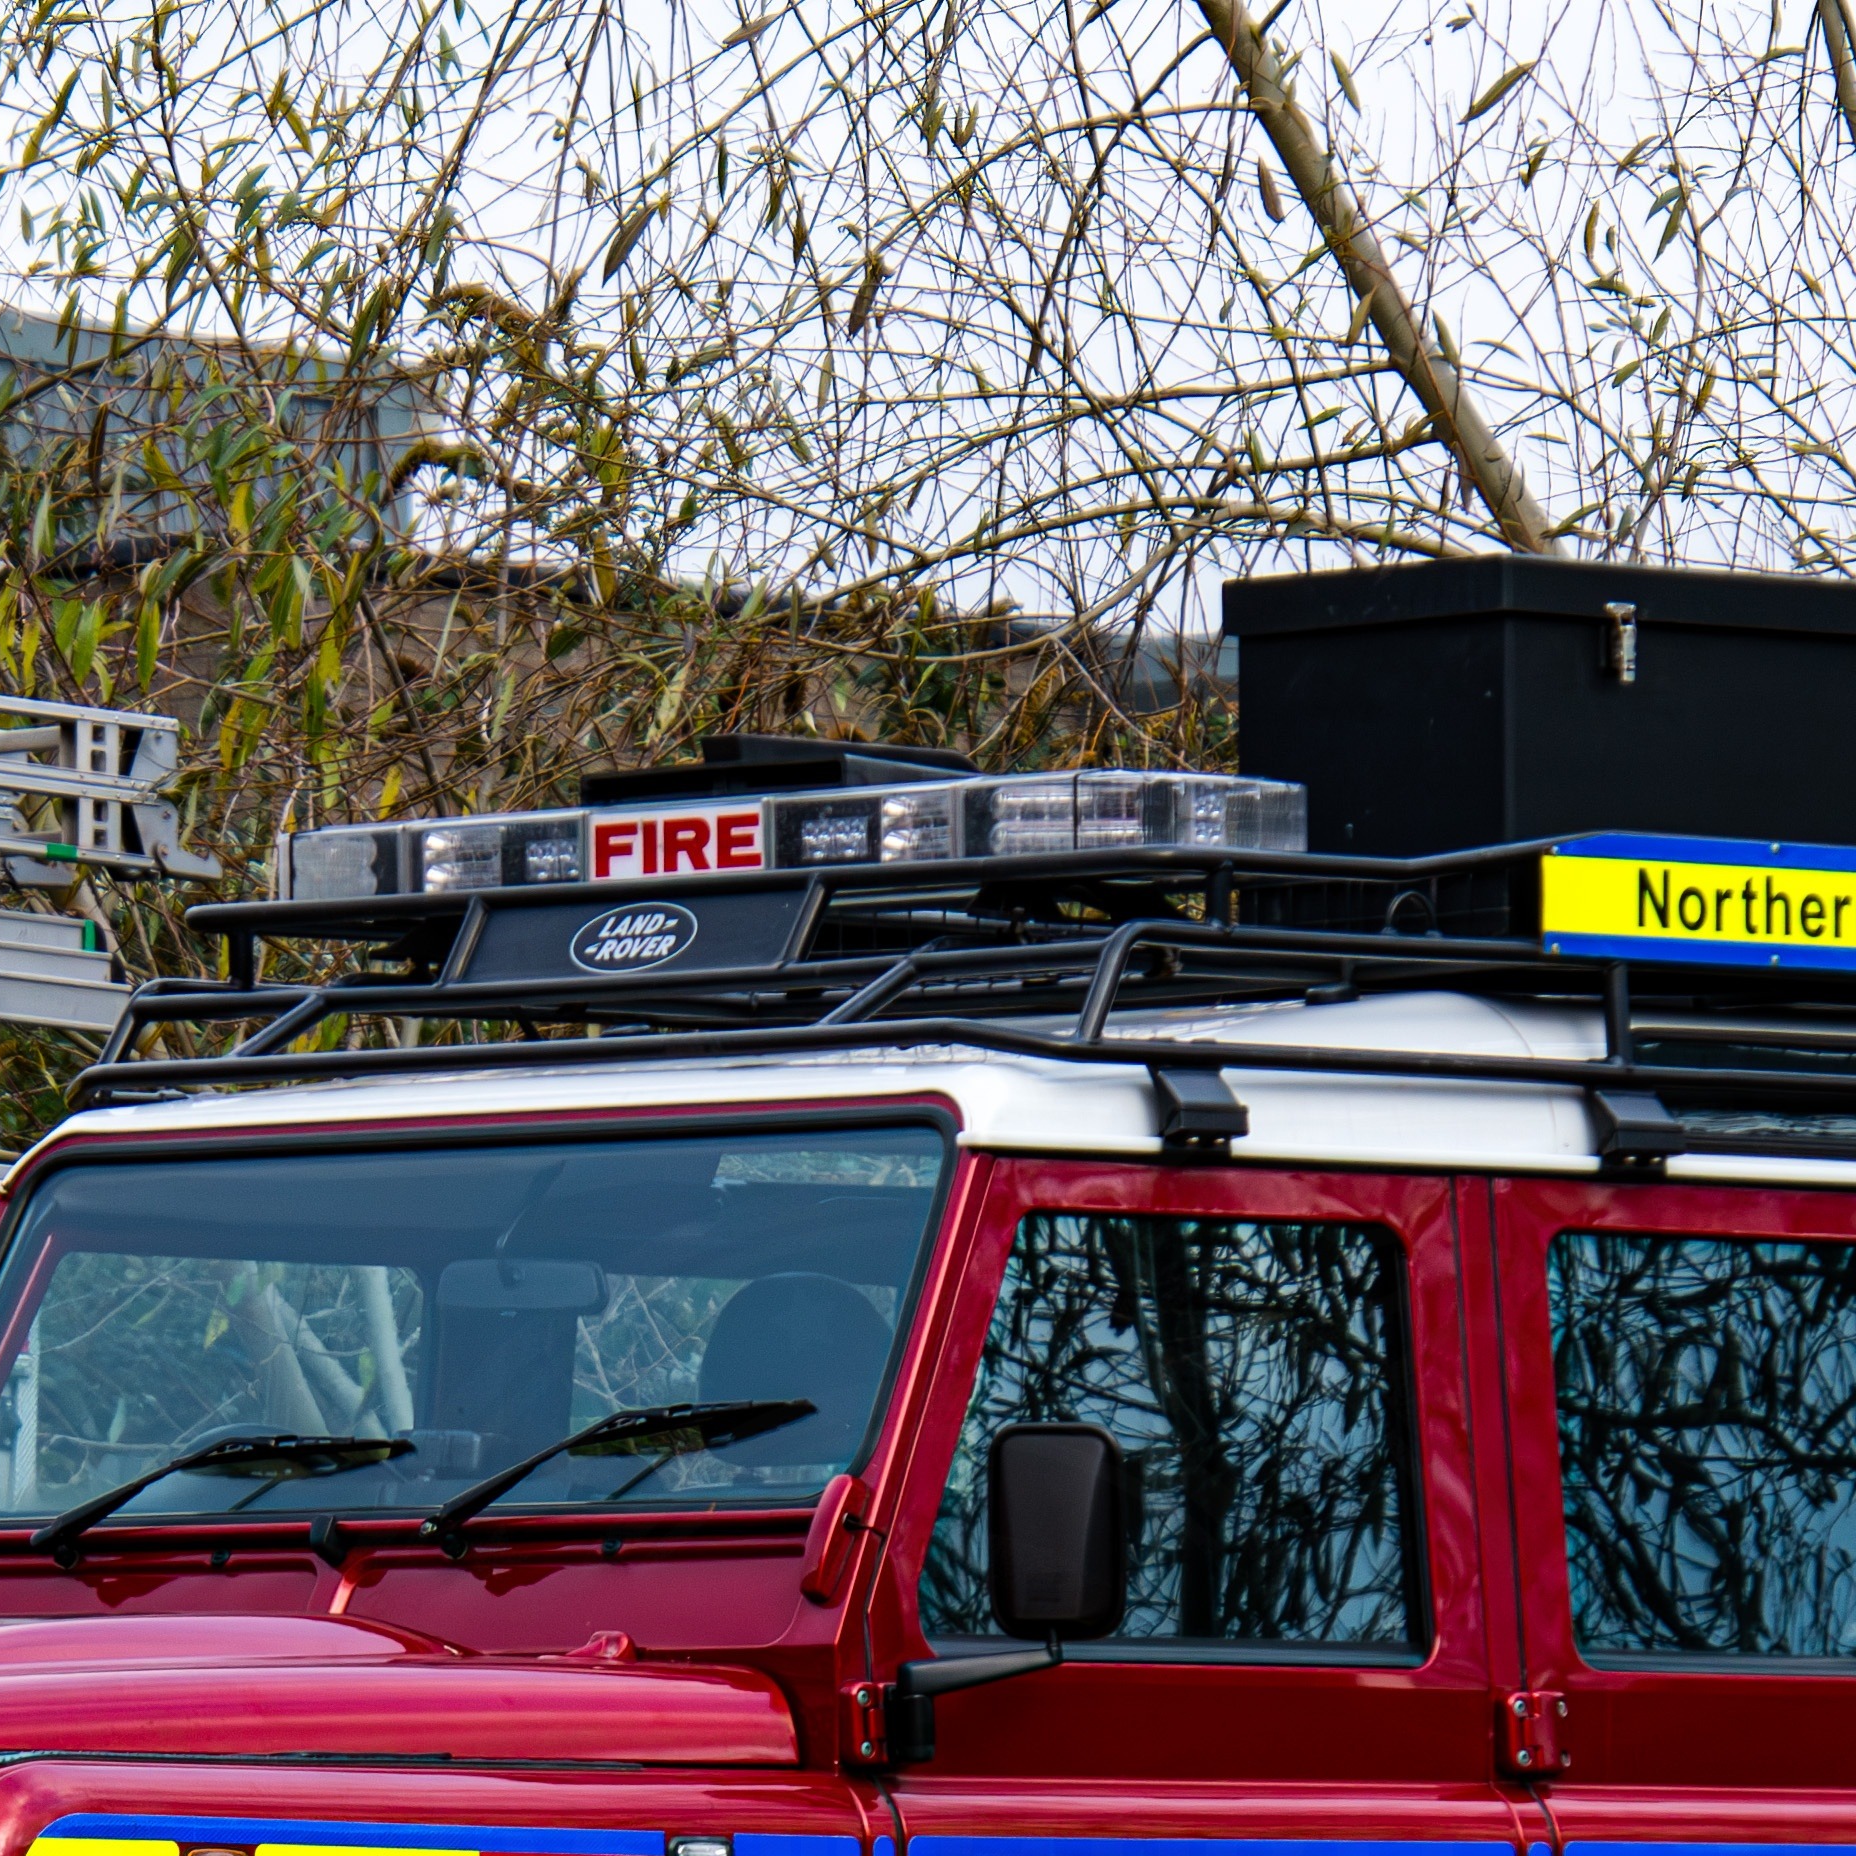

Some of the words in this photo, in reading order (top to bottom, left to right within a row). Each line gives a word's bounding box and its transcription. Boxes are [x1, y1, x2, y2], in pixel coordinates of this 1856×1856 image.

[594, 812, 763, 878] FIRE
[597, 912, 668, 939] LAND
[592, 934, 677, 961] ROVER
